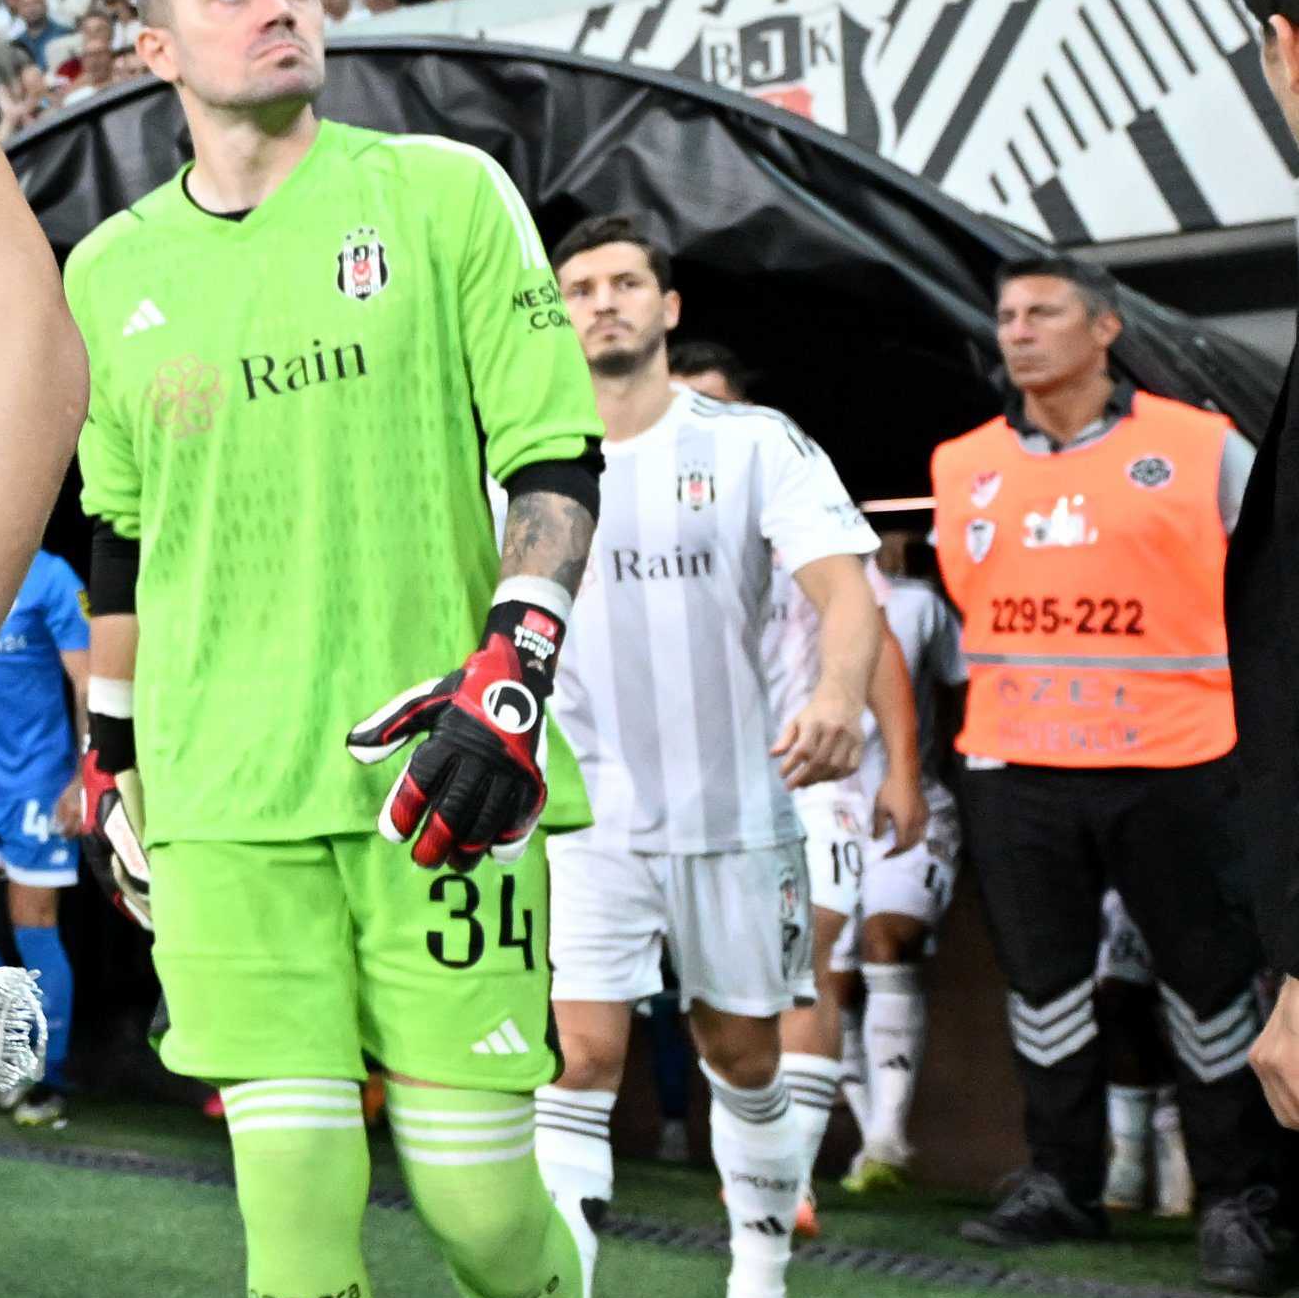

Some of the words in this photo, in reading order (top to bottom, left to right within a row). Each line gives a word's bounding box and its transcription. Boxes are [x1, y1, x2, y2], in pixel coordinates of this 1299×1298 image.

[241, 339, 366, 401] Rain
[612, 545, 711, 582] Rain
[991, 597, 1145, 637] 2295-222
[425, 874, 535, 971] 34
